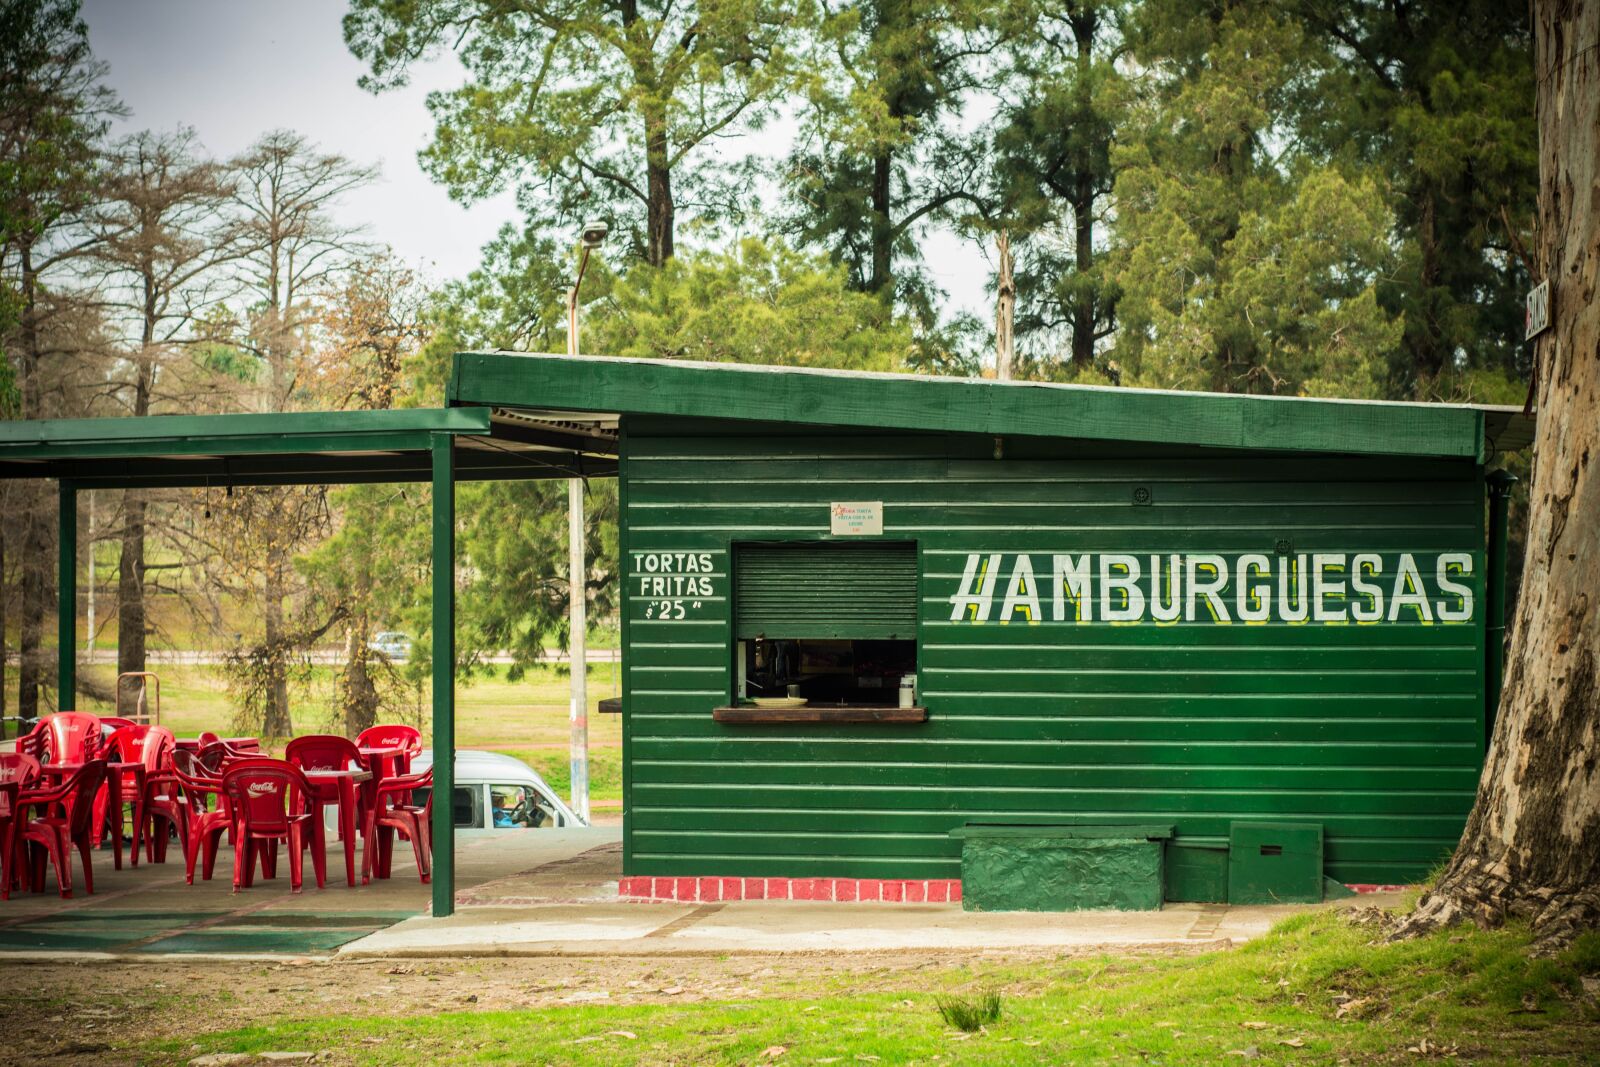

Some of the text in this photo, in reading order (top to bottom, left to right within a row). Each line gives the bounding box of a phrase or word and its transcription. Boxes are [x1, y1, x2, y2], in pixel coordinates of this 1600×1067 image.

[634, 553, 714, 573] TORTAS
[640, 577, 714, 596] FRITAS
[948, 553, 1474, 623] HAMBURGUESAS
